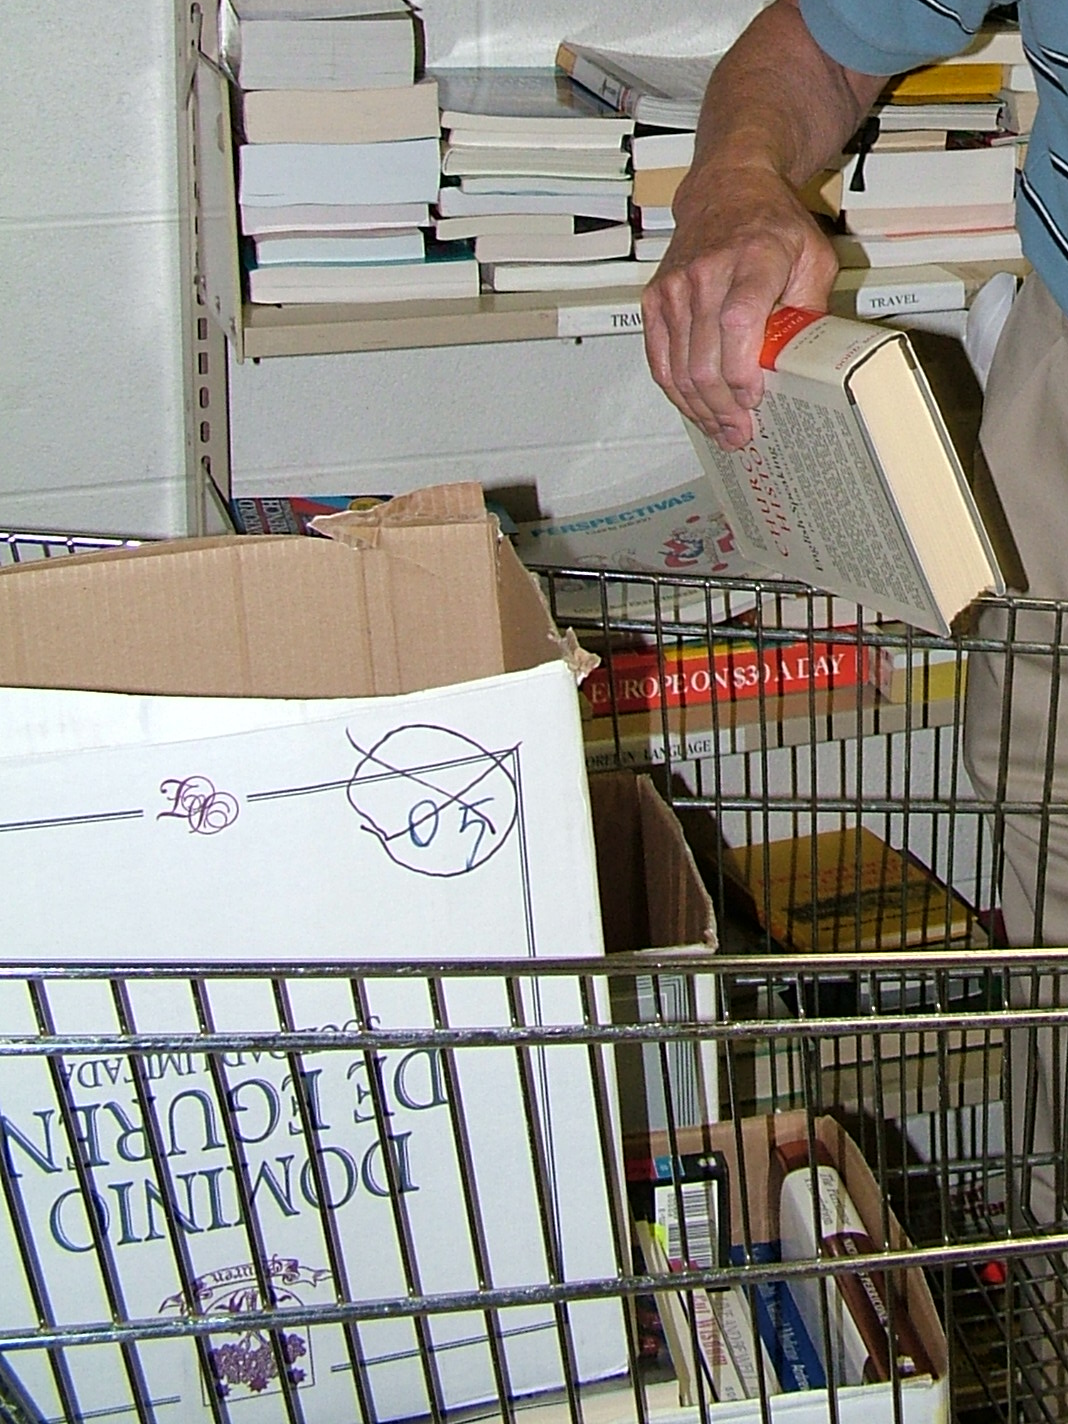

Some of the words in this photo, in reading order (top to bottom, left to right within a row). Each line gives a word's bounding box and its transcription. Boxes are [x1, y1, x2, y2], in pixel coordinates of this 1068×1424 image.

[869, 293, 919, 309] TRAVEL
[531, 492, 696, 538] PERSPECTIVAS
[691, 667, 729, 692] ON
[774, 660, 792, 682] A
[644, 739, 713, 761] LANGUAGE
[49, 1130, 420, 1254] DOMINIO
